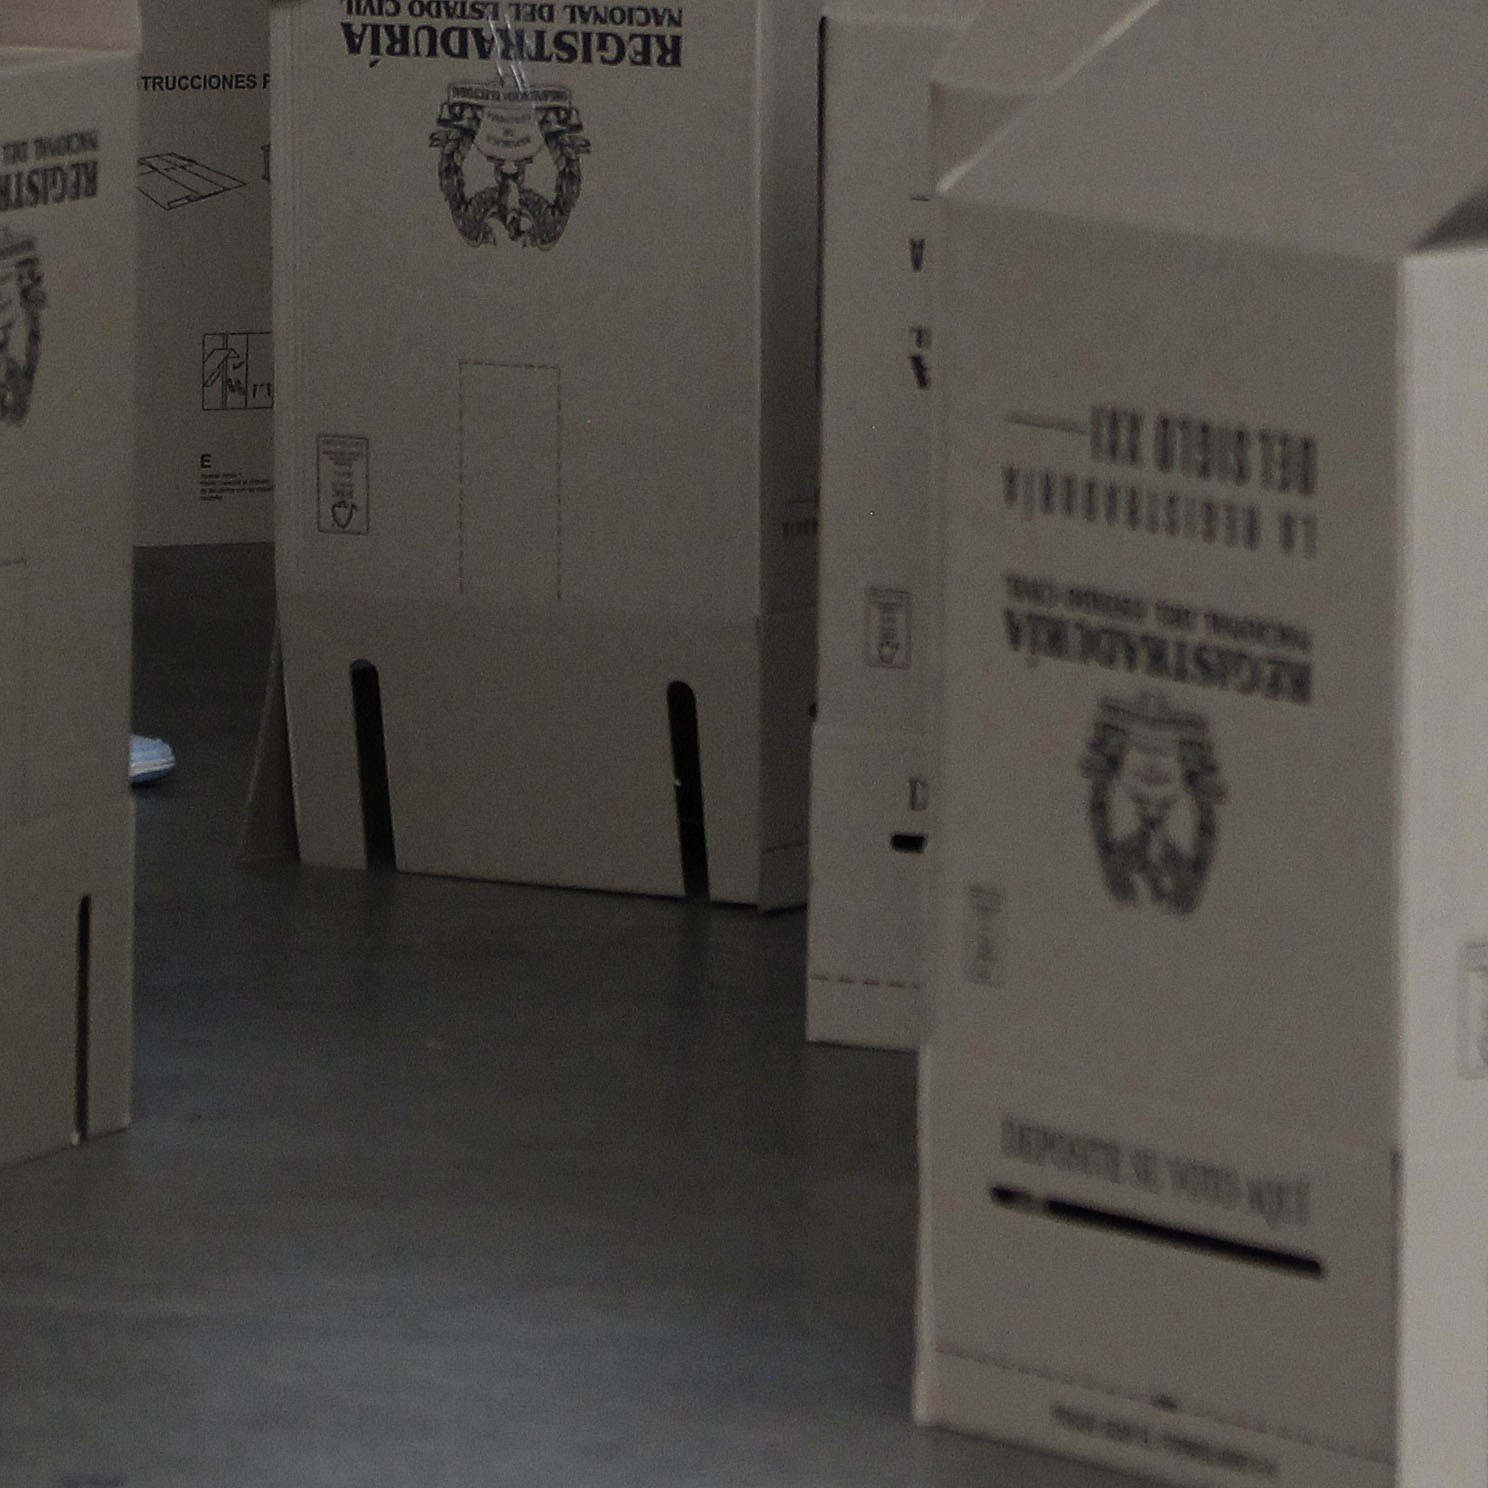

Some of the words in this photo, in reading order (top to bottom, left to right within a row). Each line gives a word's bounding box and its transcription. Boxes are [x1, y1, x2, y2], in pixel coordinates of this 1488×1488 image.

[563, 5, 682, 27] NACIONAL
[342, 20, 682, 69] REGISTRADURÍA
[200, 454, 211, 469] E
